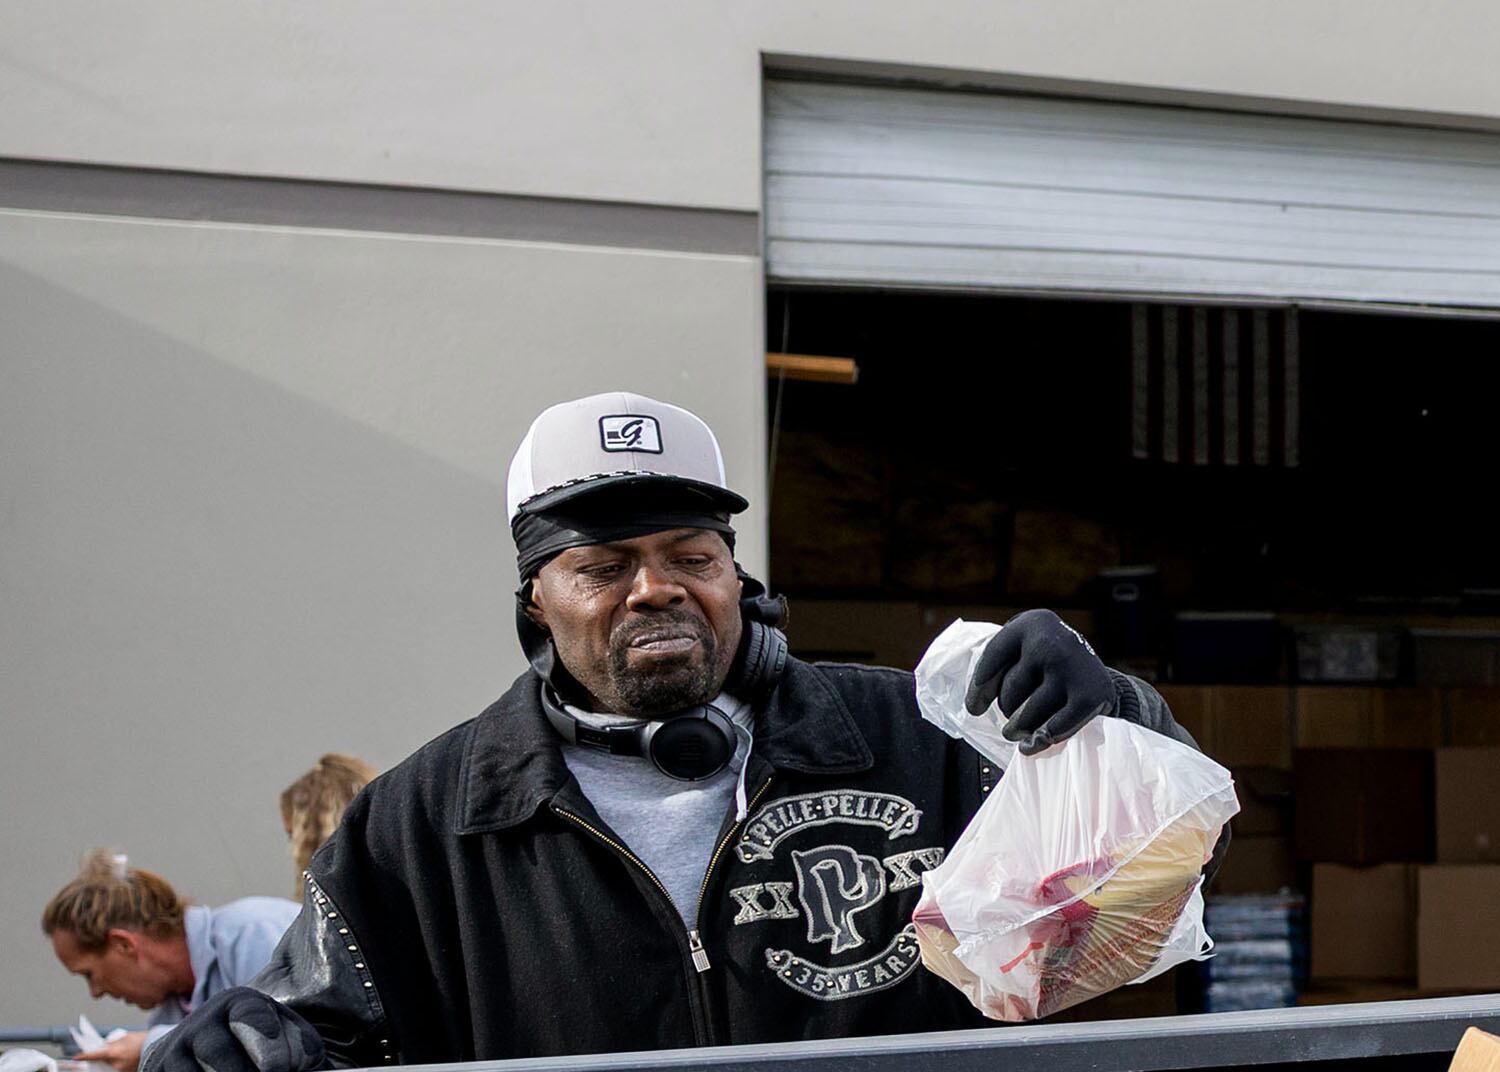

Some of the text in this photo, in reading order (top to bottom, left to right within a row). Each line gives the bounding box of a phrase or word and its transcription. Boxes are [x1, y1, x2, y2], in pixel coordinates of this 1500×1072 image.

[748, 795, 902, 842] PELLE PELLE
[730, 881, 799, 926] XX
[791, 844, 887, 955] P
[795, 943, 917, 993] 35 YEARS
